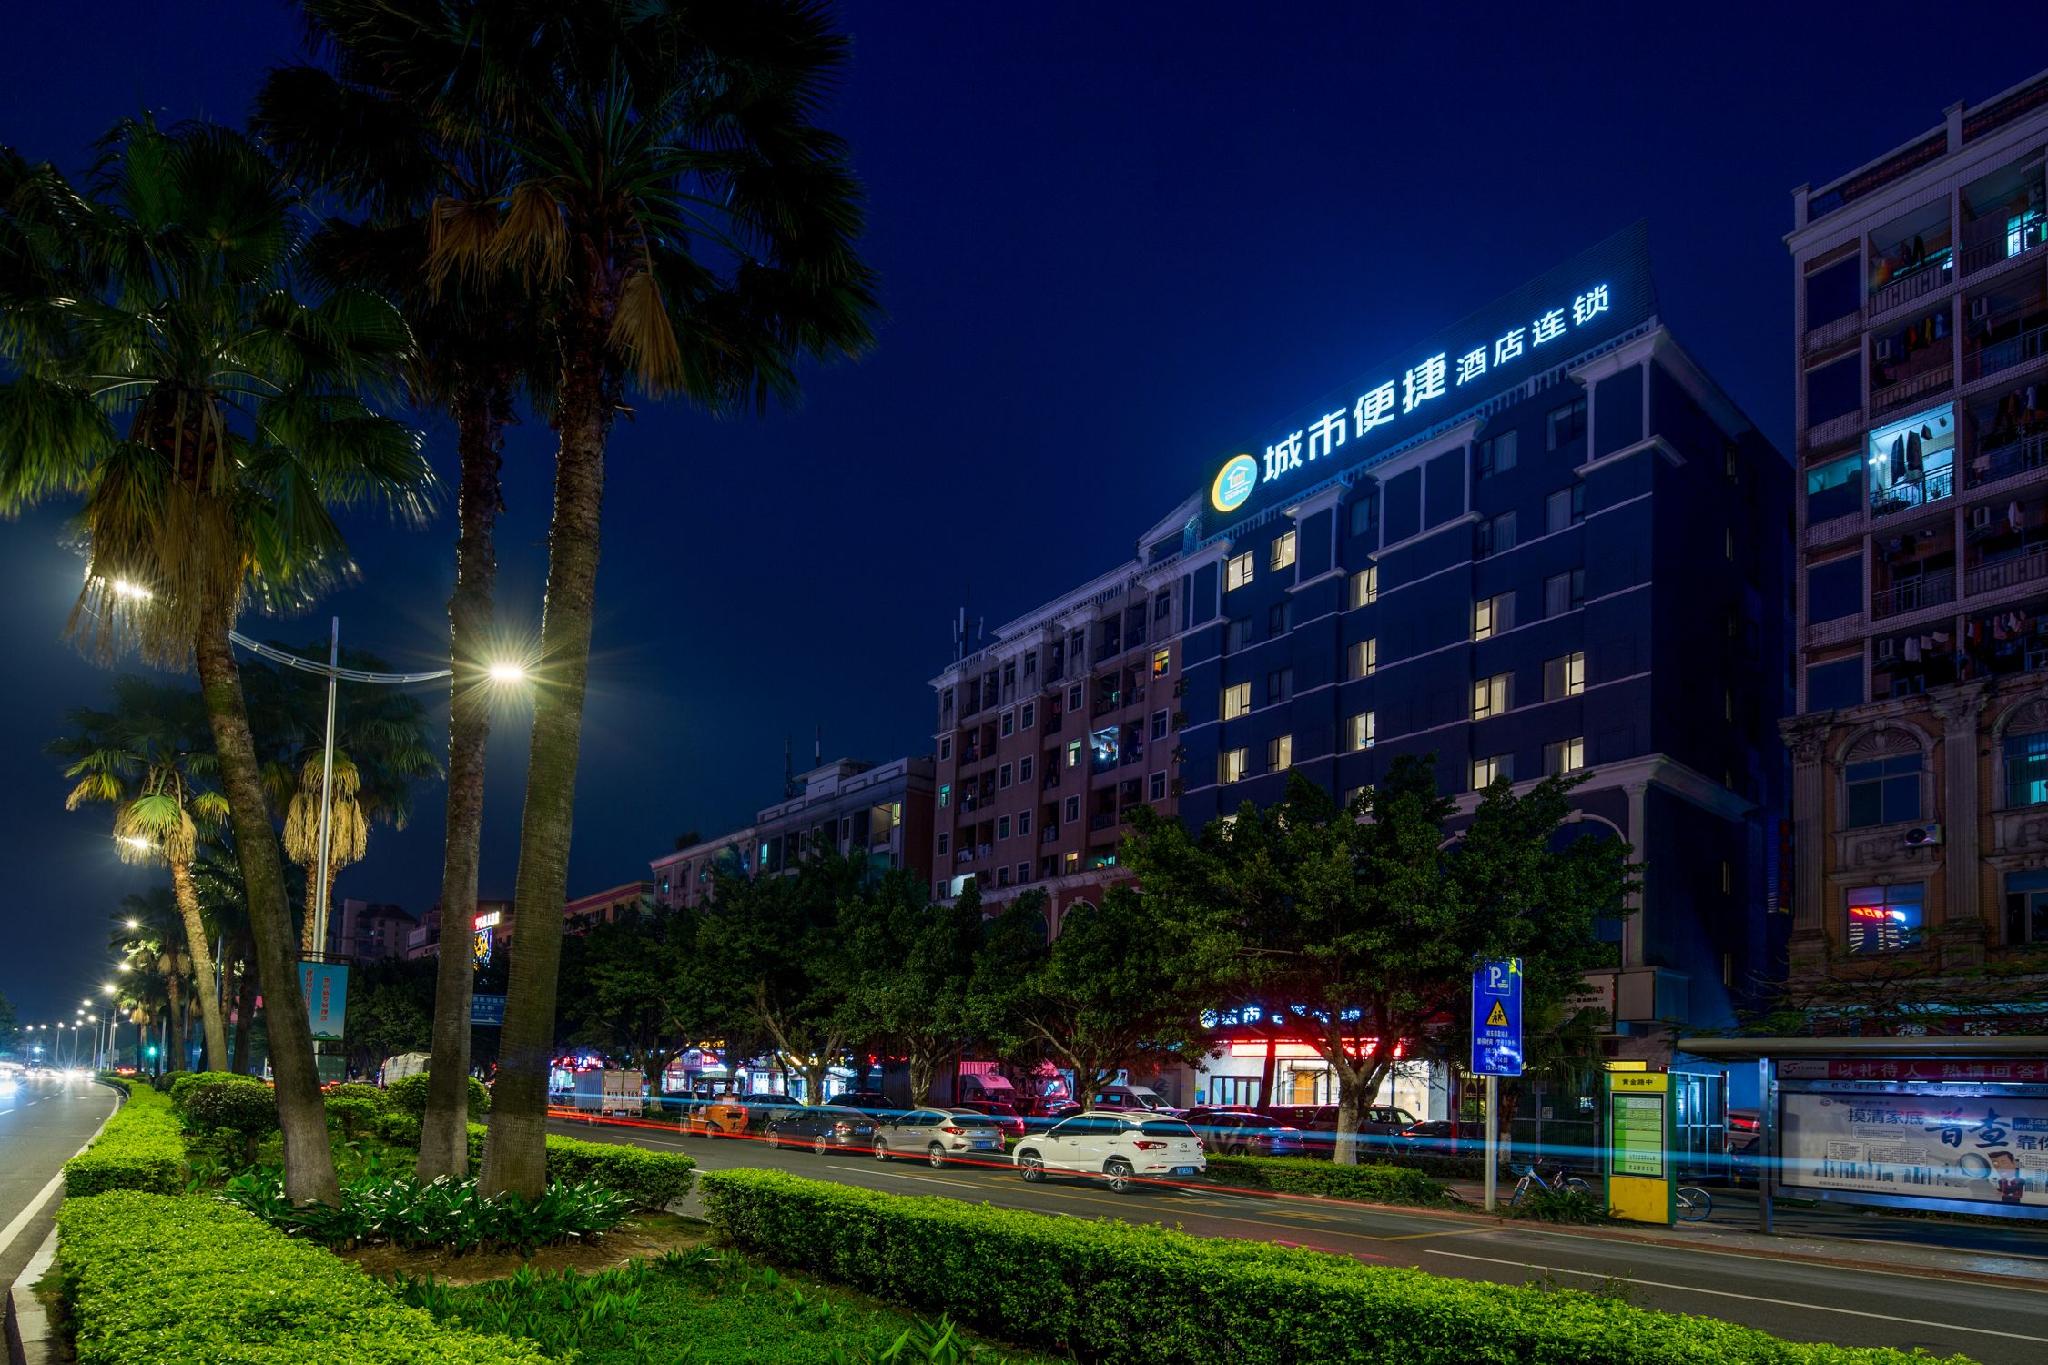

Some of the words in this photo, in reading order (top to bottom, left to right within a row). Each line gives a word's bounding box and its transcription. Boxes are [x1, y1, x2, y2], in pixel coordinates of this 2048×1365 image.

[1262, 351, 1446, 483] 城市便捷
[1455, 284, 1609, 386] 酒店连锁
